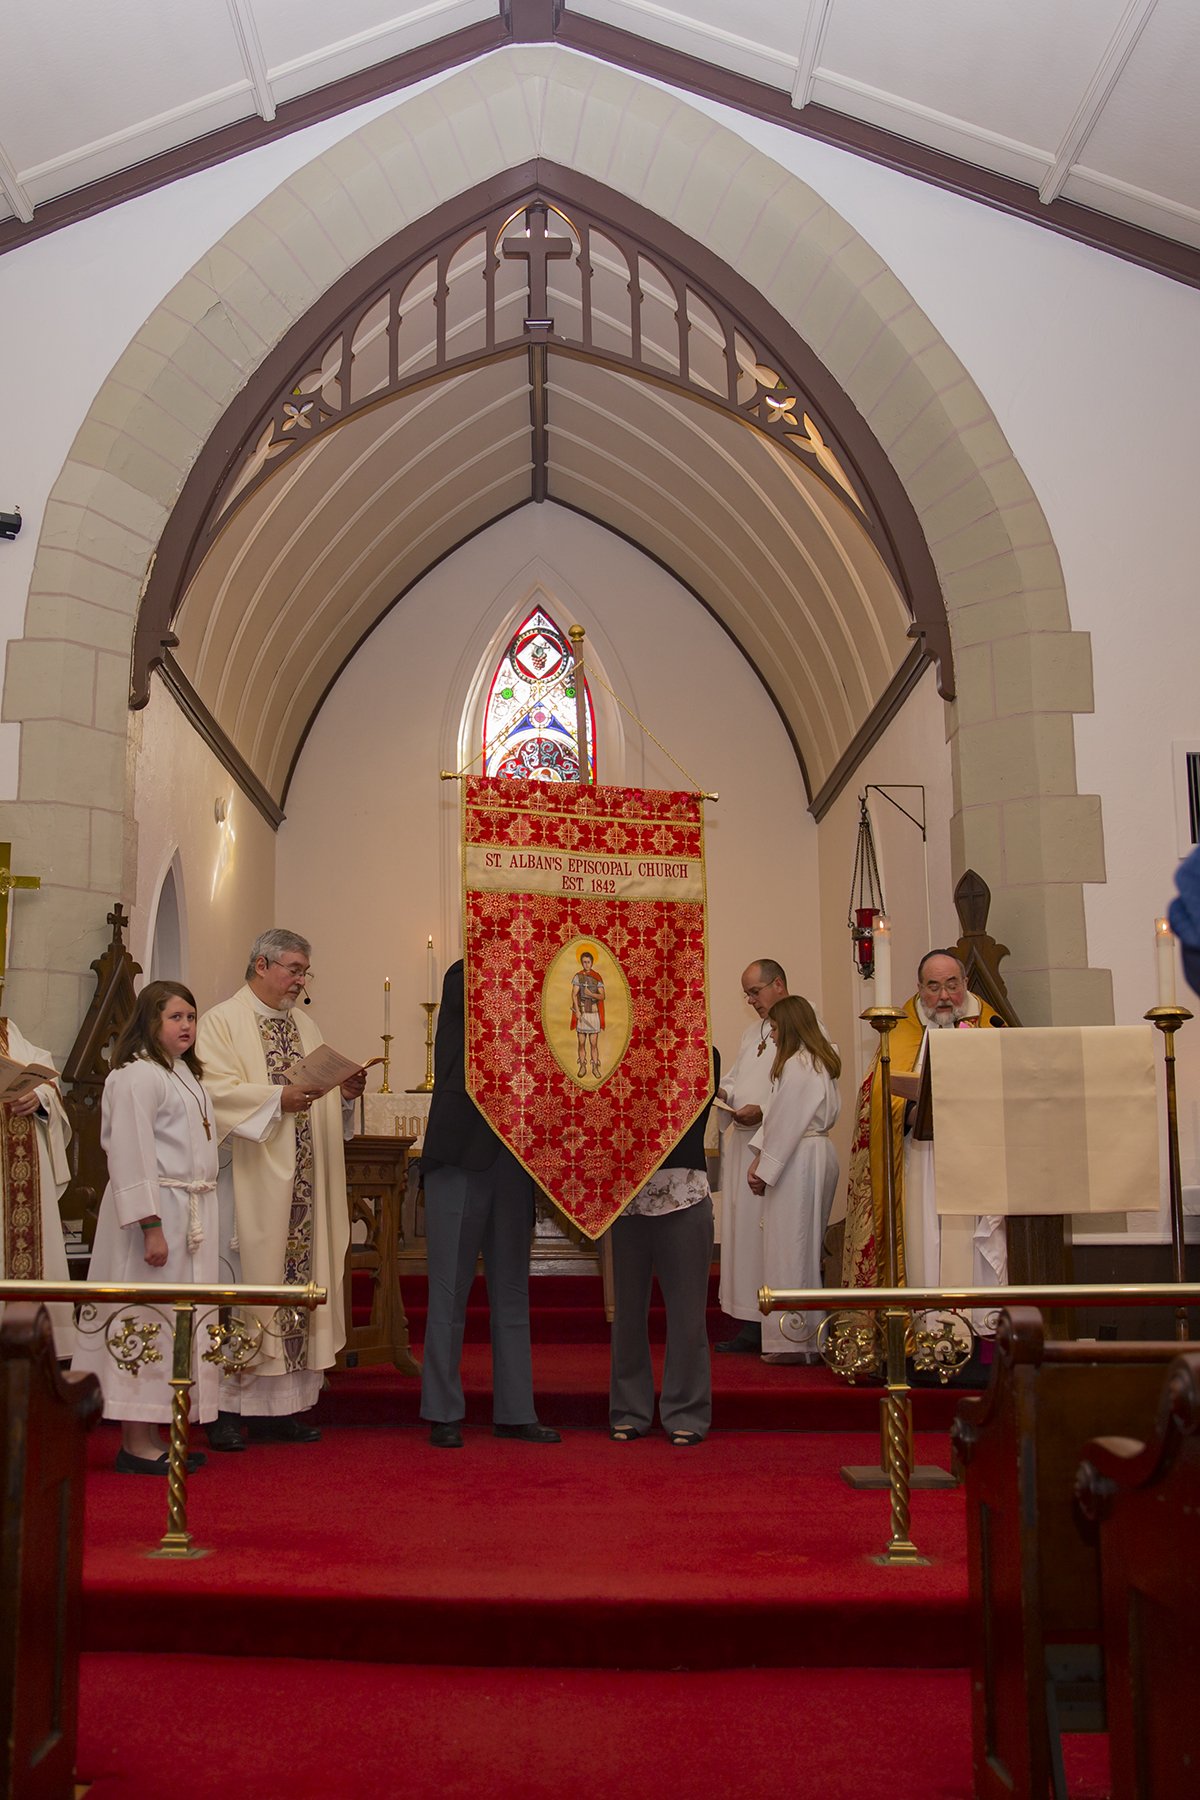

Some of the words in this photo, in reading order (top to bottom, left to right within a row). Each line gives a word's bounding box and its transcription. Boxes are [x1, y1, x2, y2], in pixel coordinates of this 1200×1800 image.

[485, 852, 502, 868] ST.
[509, 854, 563, 871] ALBAN'S
[568, 858, 632, 876] EPISCOPAL
[638, 862, 688, 878] CHURCH
[561, 875, 584, 892] EST.
[591, 878, 616, 894] 1842
